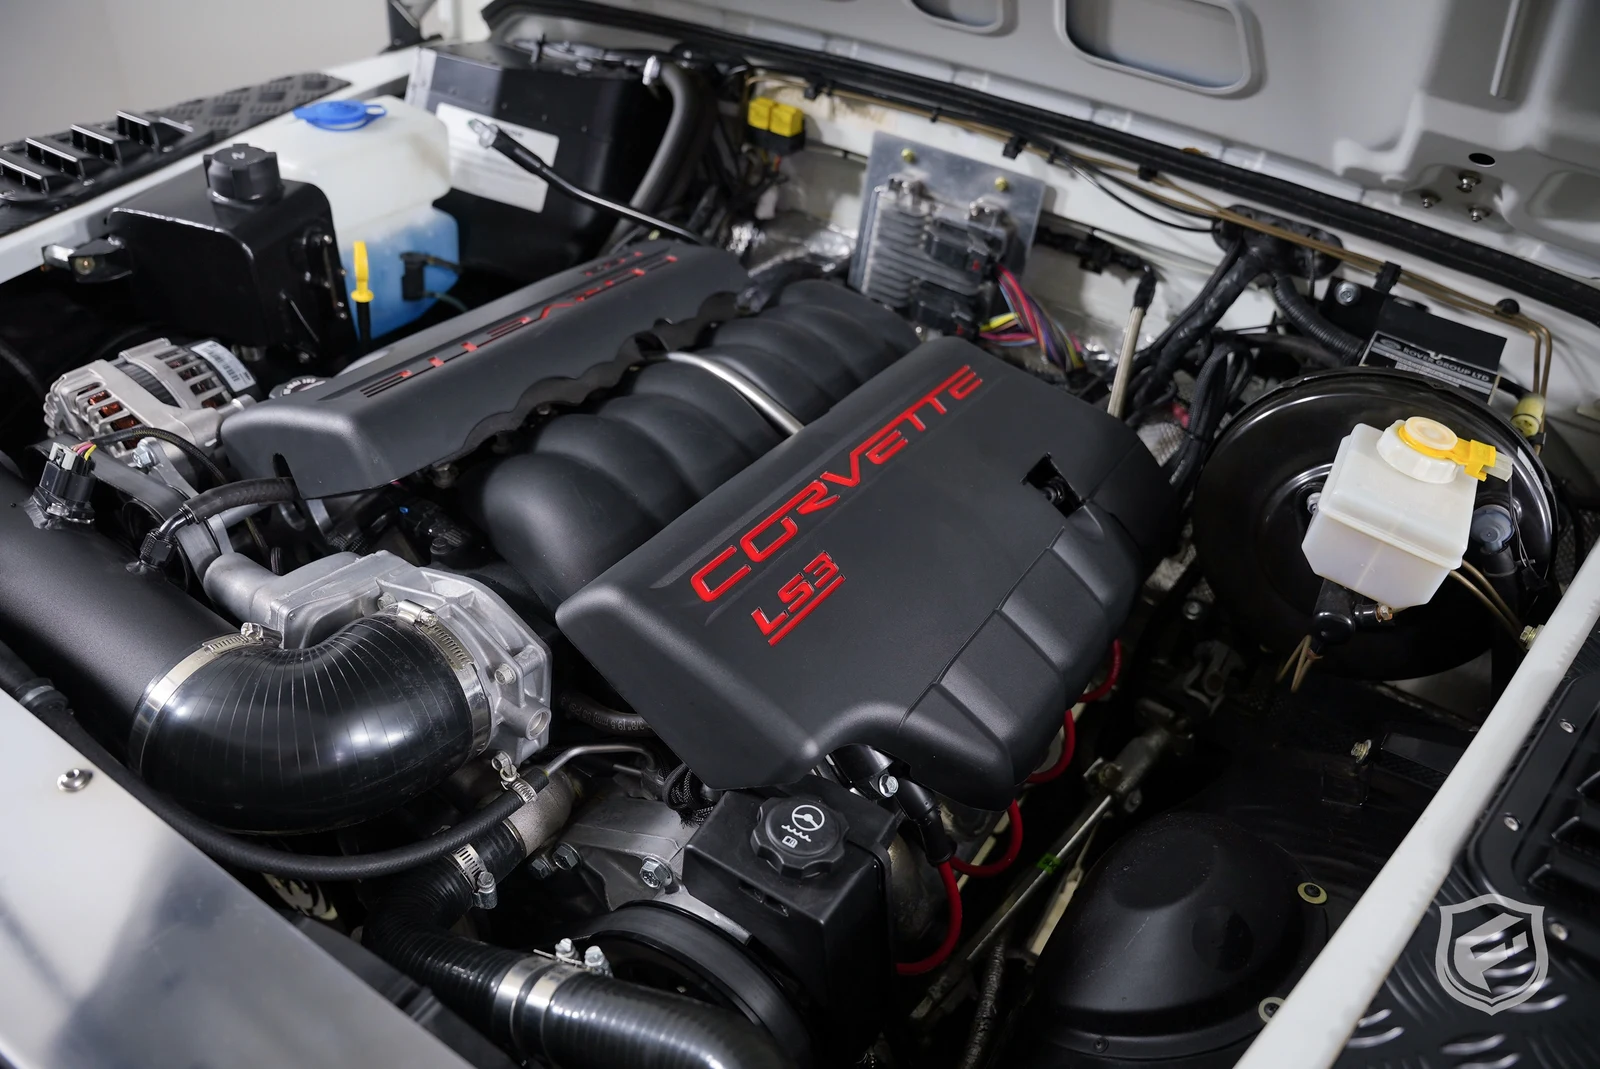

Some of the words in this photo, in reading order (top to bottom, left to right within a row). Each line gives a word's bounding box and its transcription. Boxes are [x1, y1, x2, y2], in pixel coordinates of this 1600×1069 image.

[1403, 346, 1436, 362] ROVER
[1436, 358, 1471, 375] GROUP
[1471, 371, 1490, 382] LTD
[690, 364, 983, 603] CORVETTE
[750, 550, 840, 636] LS3
